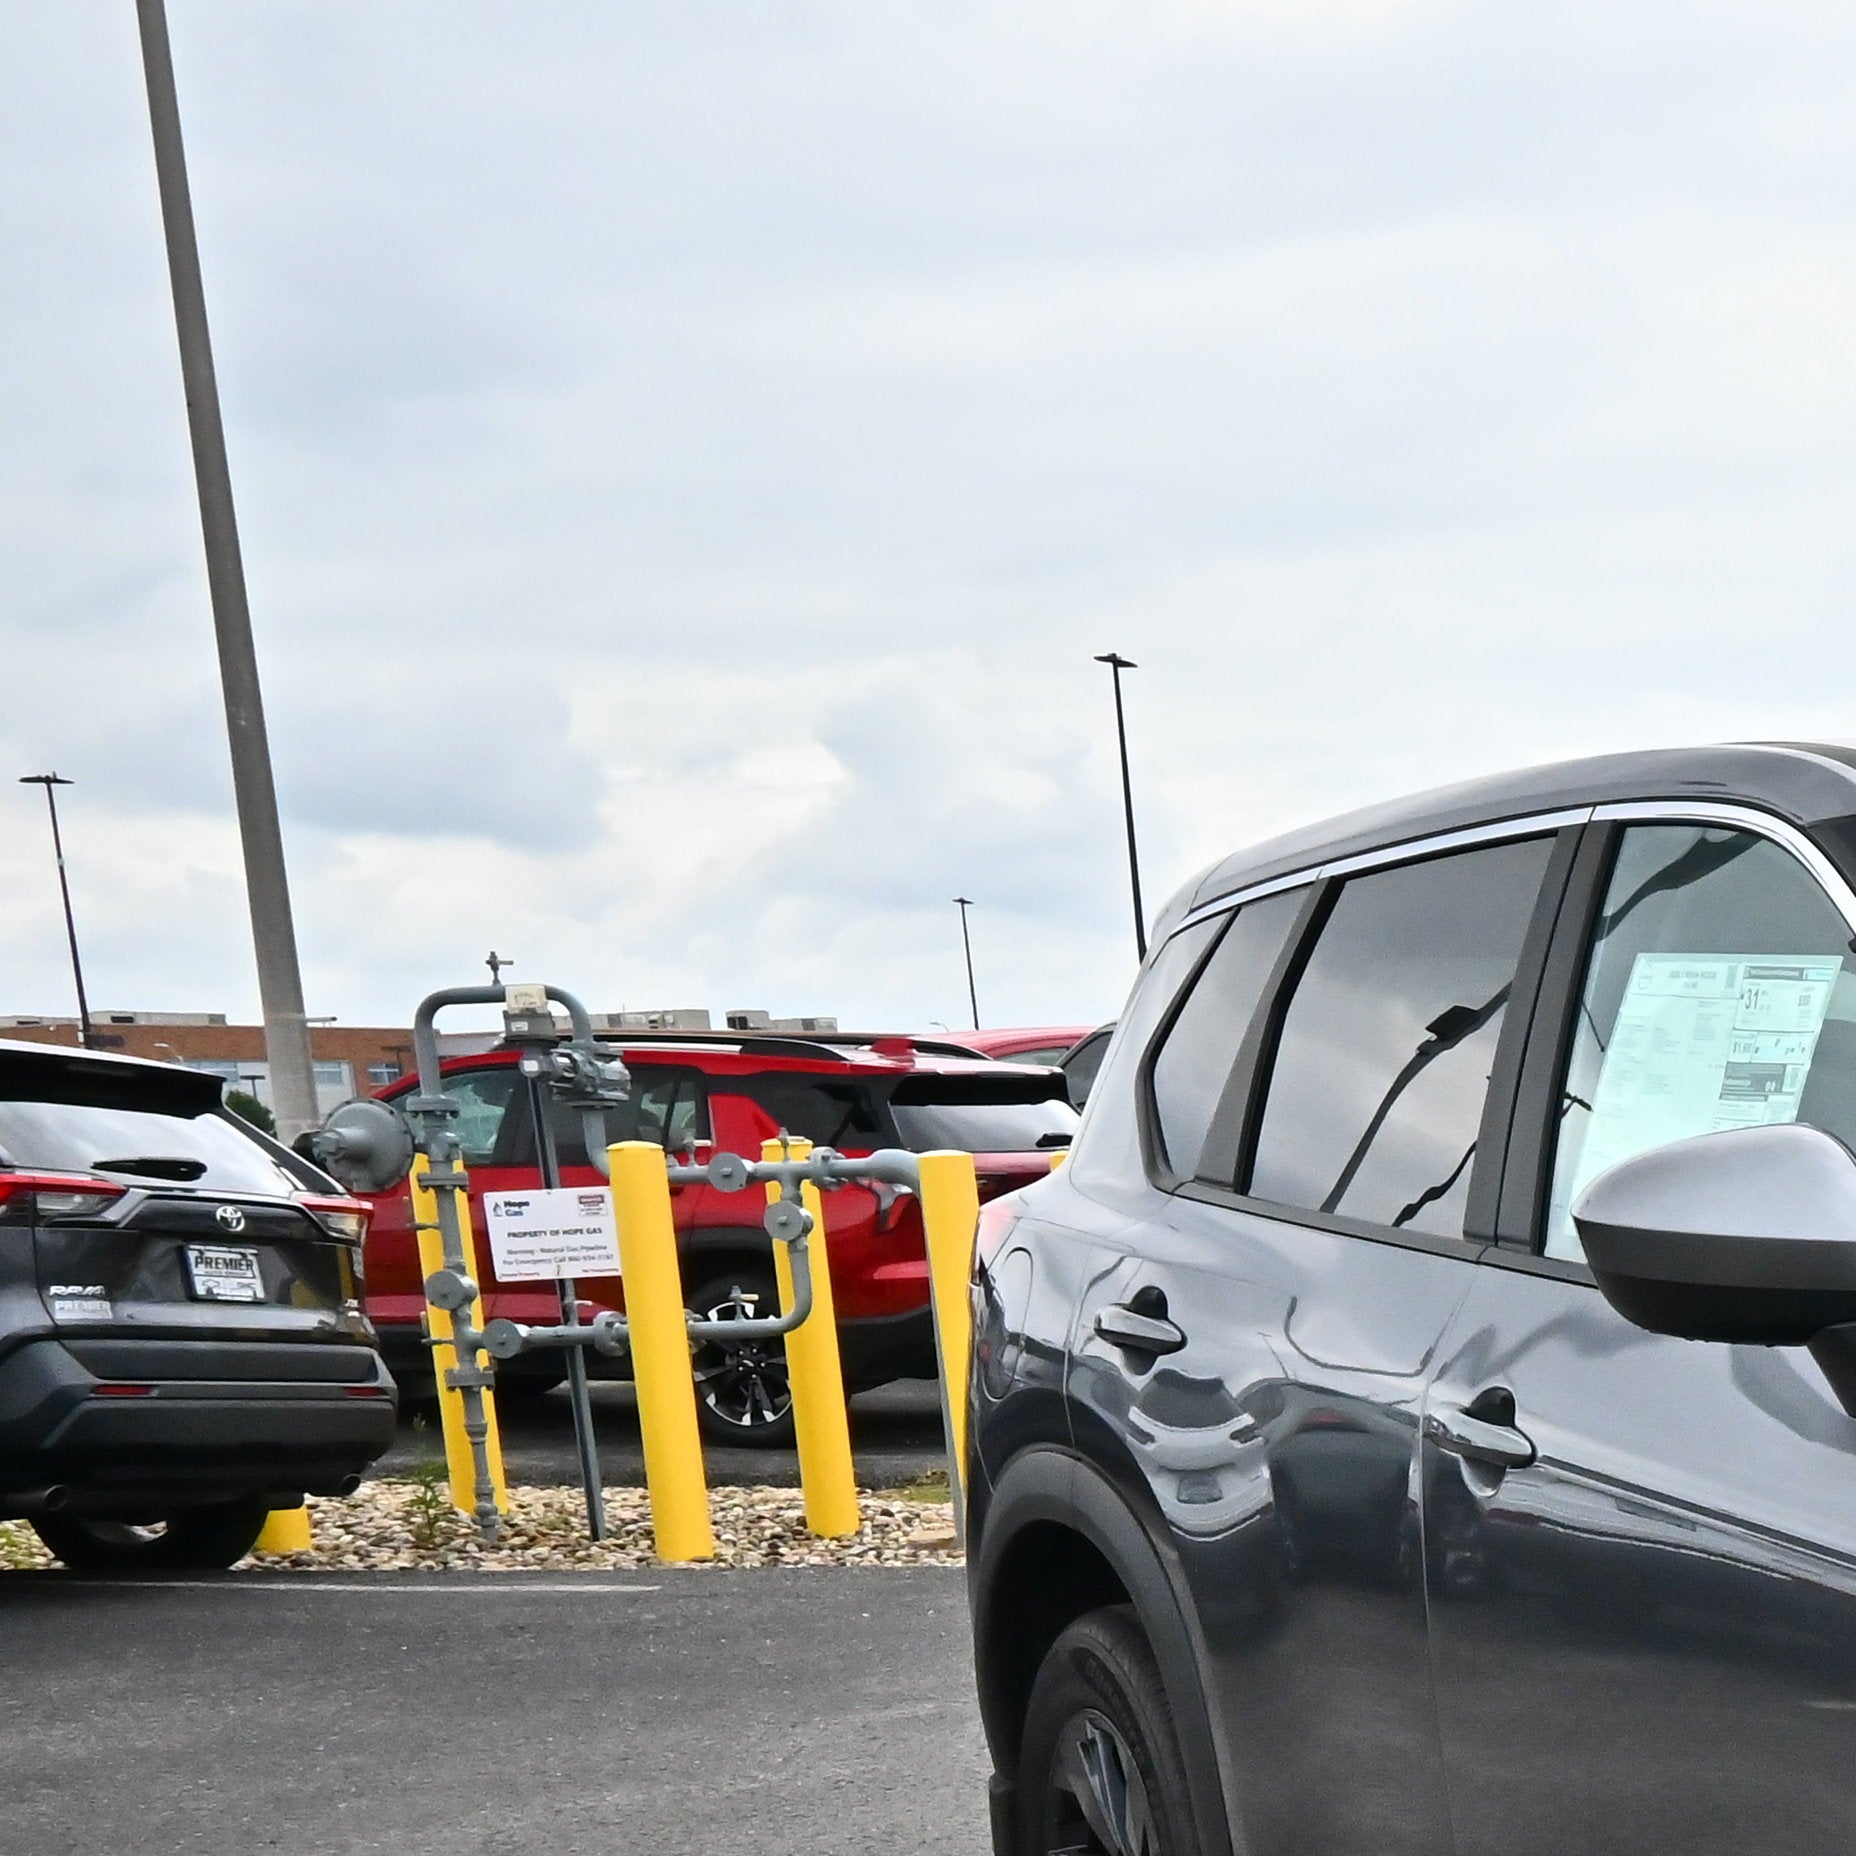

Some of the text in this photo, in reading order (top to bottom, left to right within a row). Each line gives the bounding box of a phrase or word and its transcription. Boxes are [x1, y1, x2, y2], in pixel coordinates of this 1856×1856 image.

[503, 1200, 530, 1209] Hope
[505, 1209, 524, 1217] Gas
[507, 1230, 547, 1238] PROPERTY
[549, 1229, 560, 1237] OF
[562, 1228, 584, 1236] HOPE
[195, 1255, 254, 1271] PREMIER
